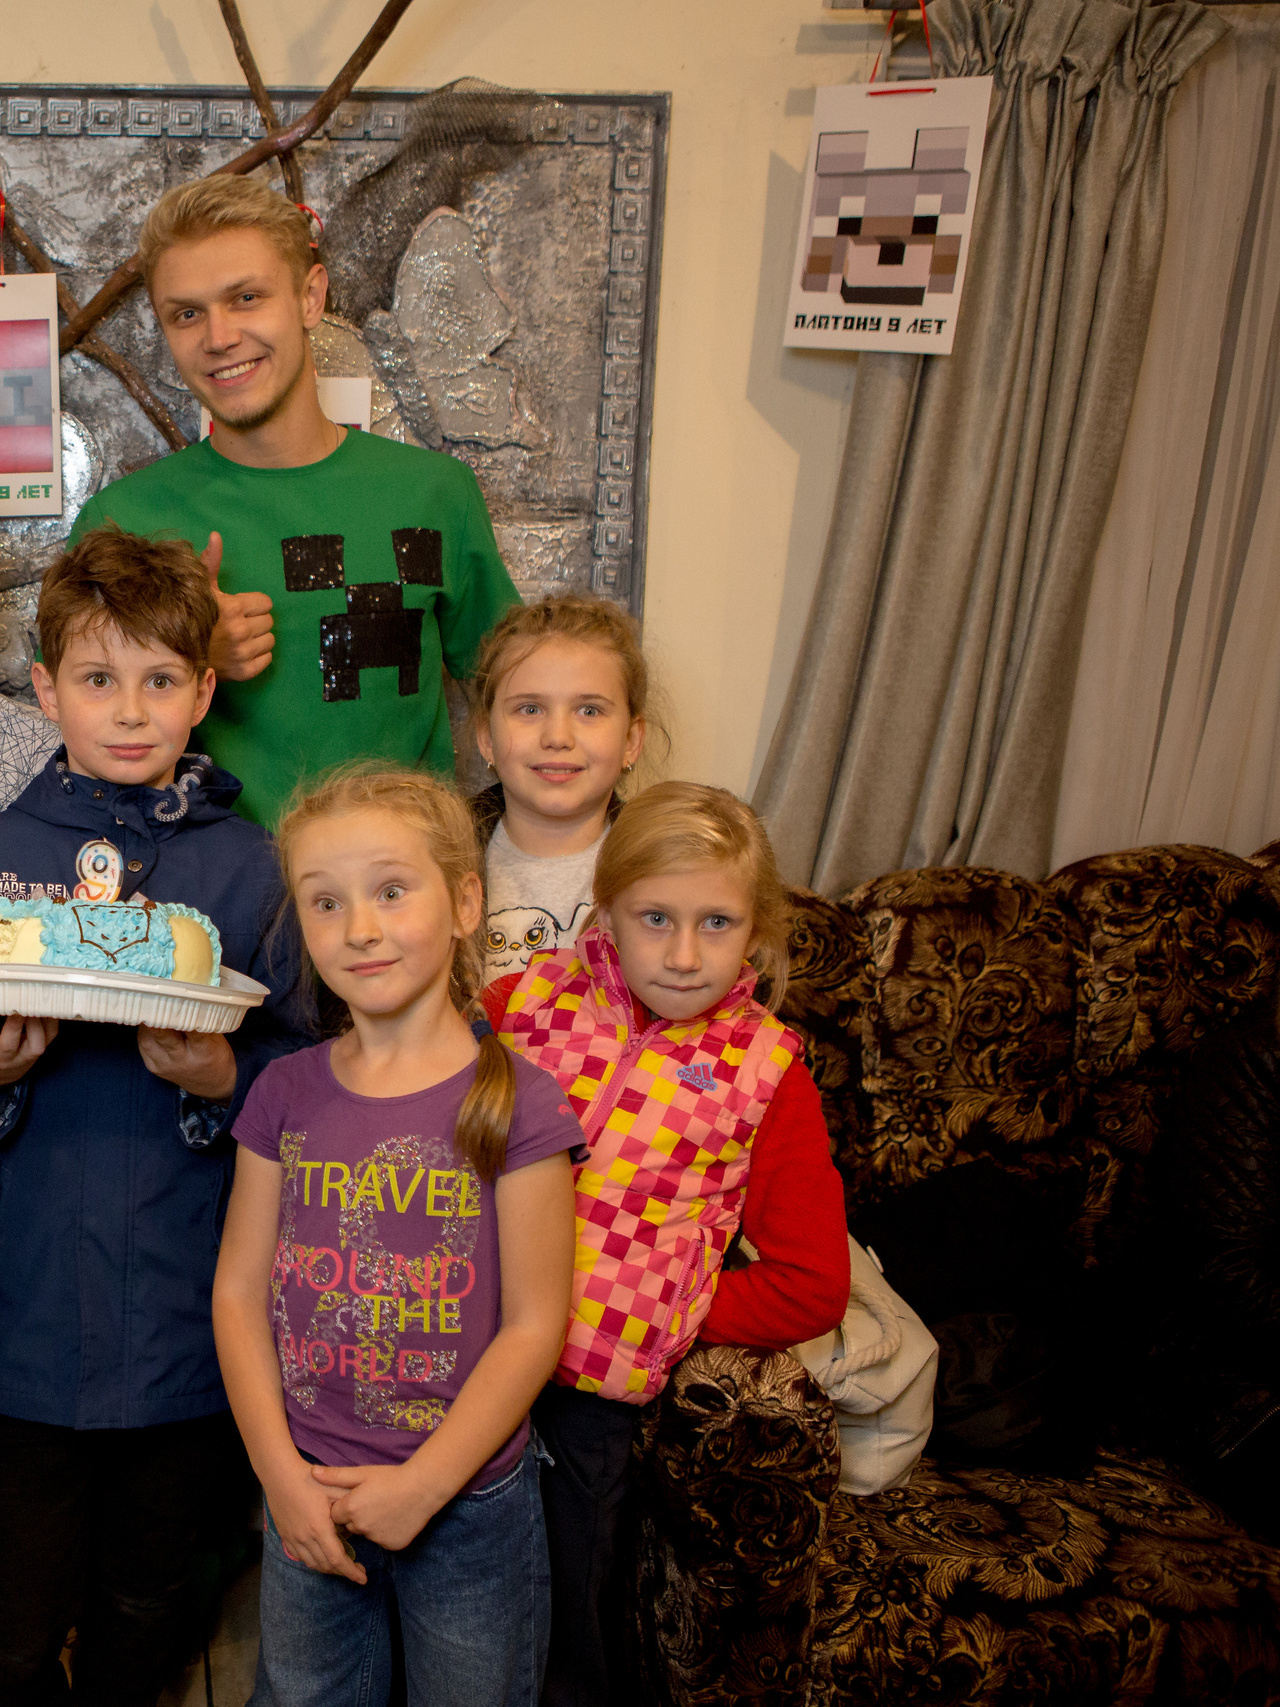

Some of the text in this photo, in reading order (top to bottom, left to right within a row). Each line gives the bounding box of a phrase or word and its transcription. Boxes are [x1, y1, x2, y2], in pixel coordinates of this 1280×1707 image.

[794, 314, 947, 335] ПЛАТОНУ 9 ЛЕТ
[17, 484, 53, 499] ЛЕТ
[47, 884, 62, 895] BE
[73, 839, 124, 904] 9
[298, 1161, 482, 1217] TRAVEL
[363, 1294, 462, 1334] THE
[280, 1331, 434, 1383] WORLD
